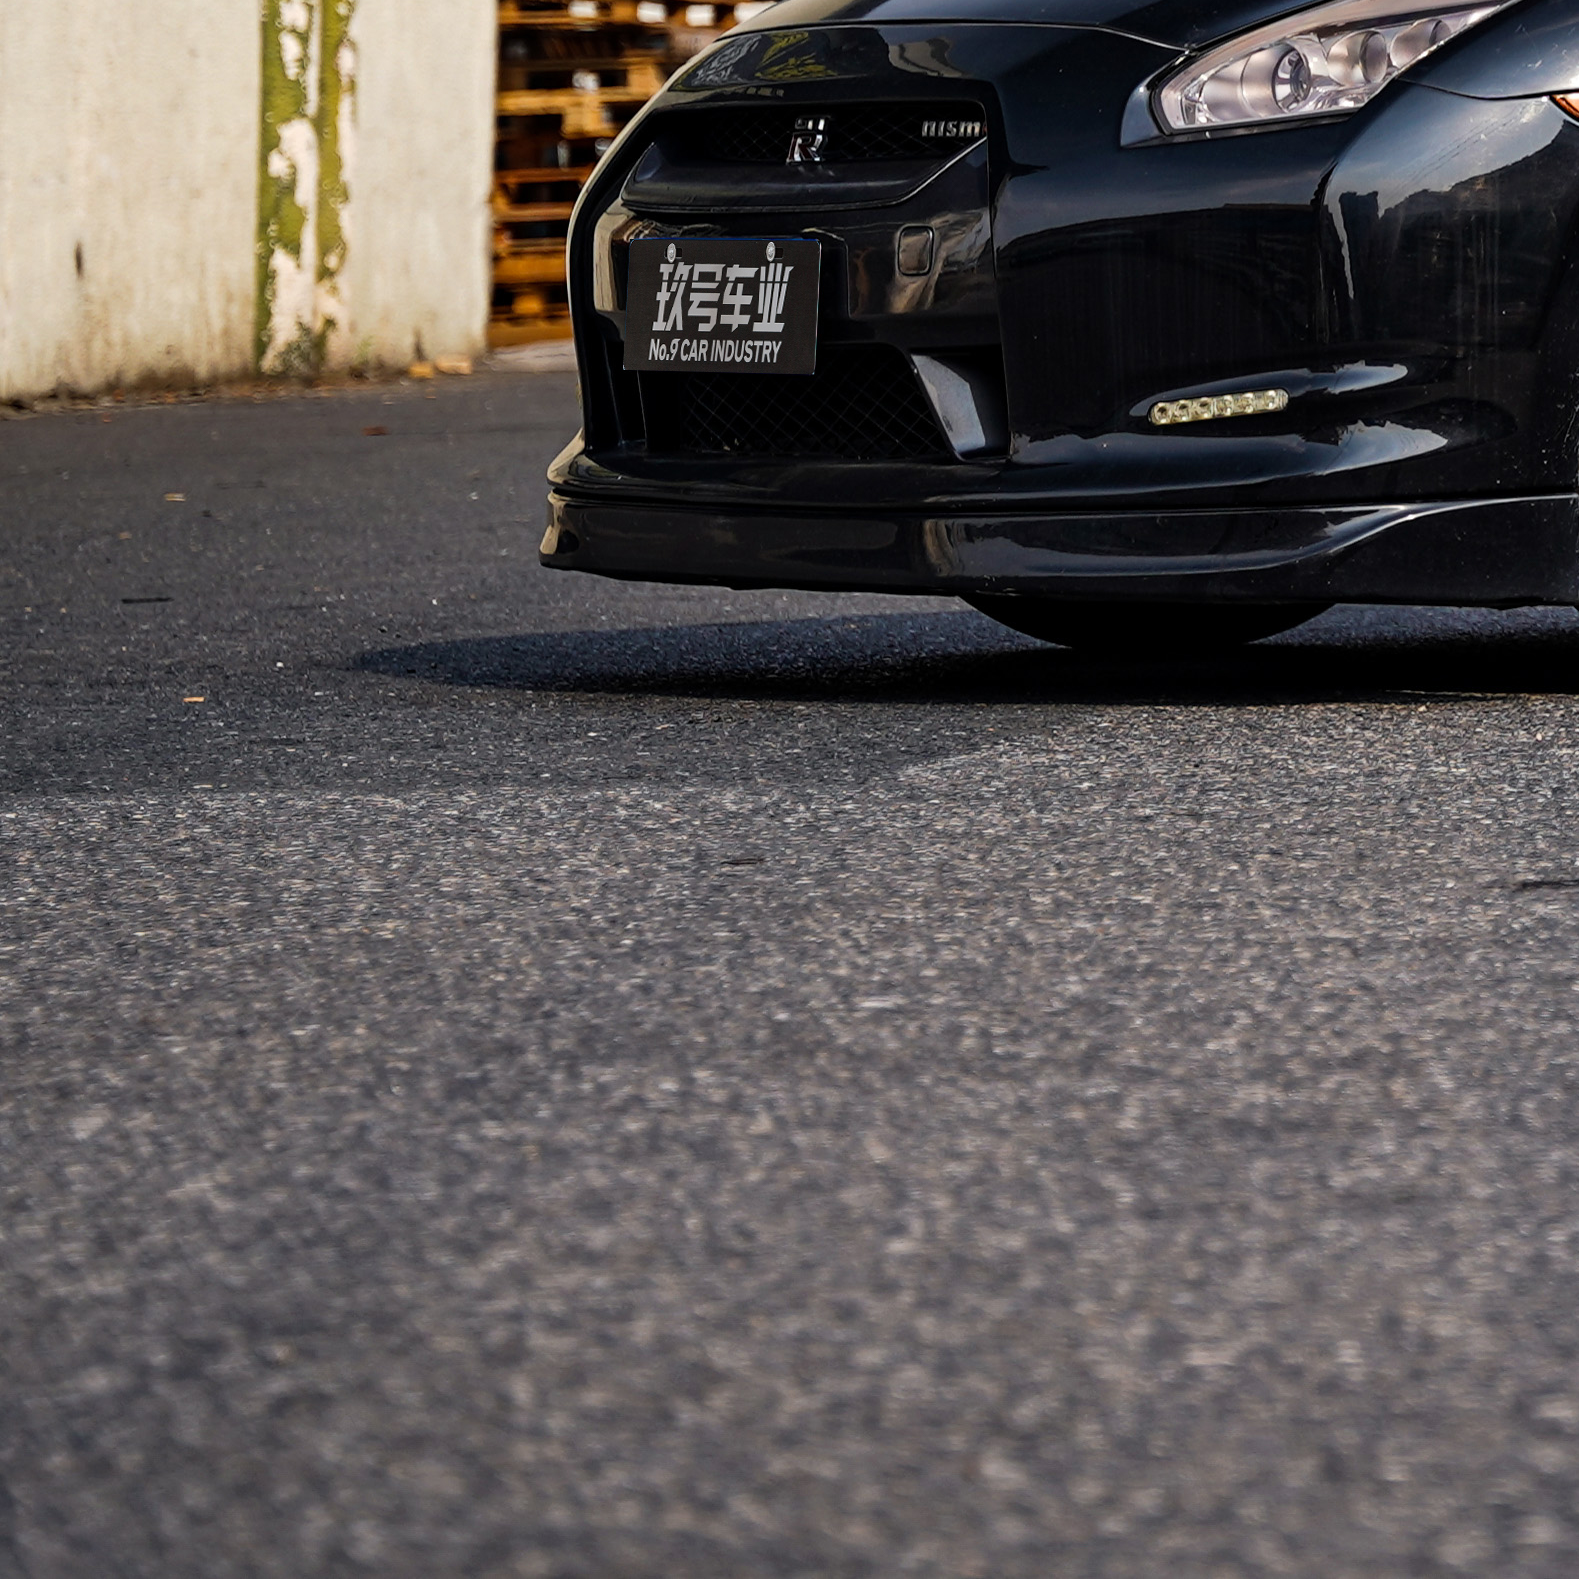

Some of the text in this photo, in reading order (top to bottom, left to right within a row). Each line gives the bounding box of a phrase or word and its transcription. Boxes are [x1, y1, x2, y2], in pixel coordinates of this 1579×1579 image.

[652, 261, 795, 332] 玖号车业
[649, 338, 782, 364] No.9 CAR INDUSTRY
